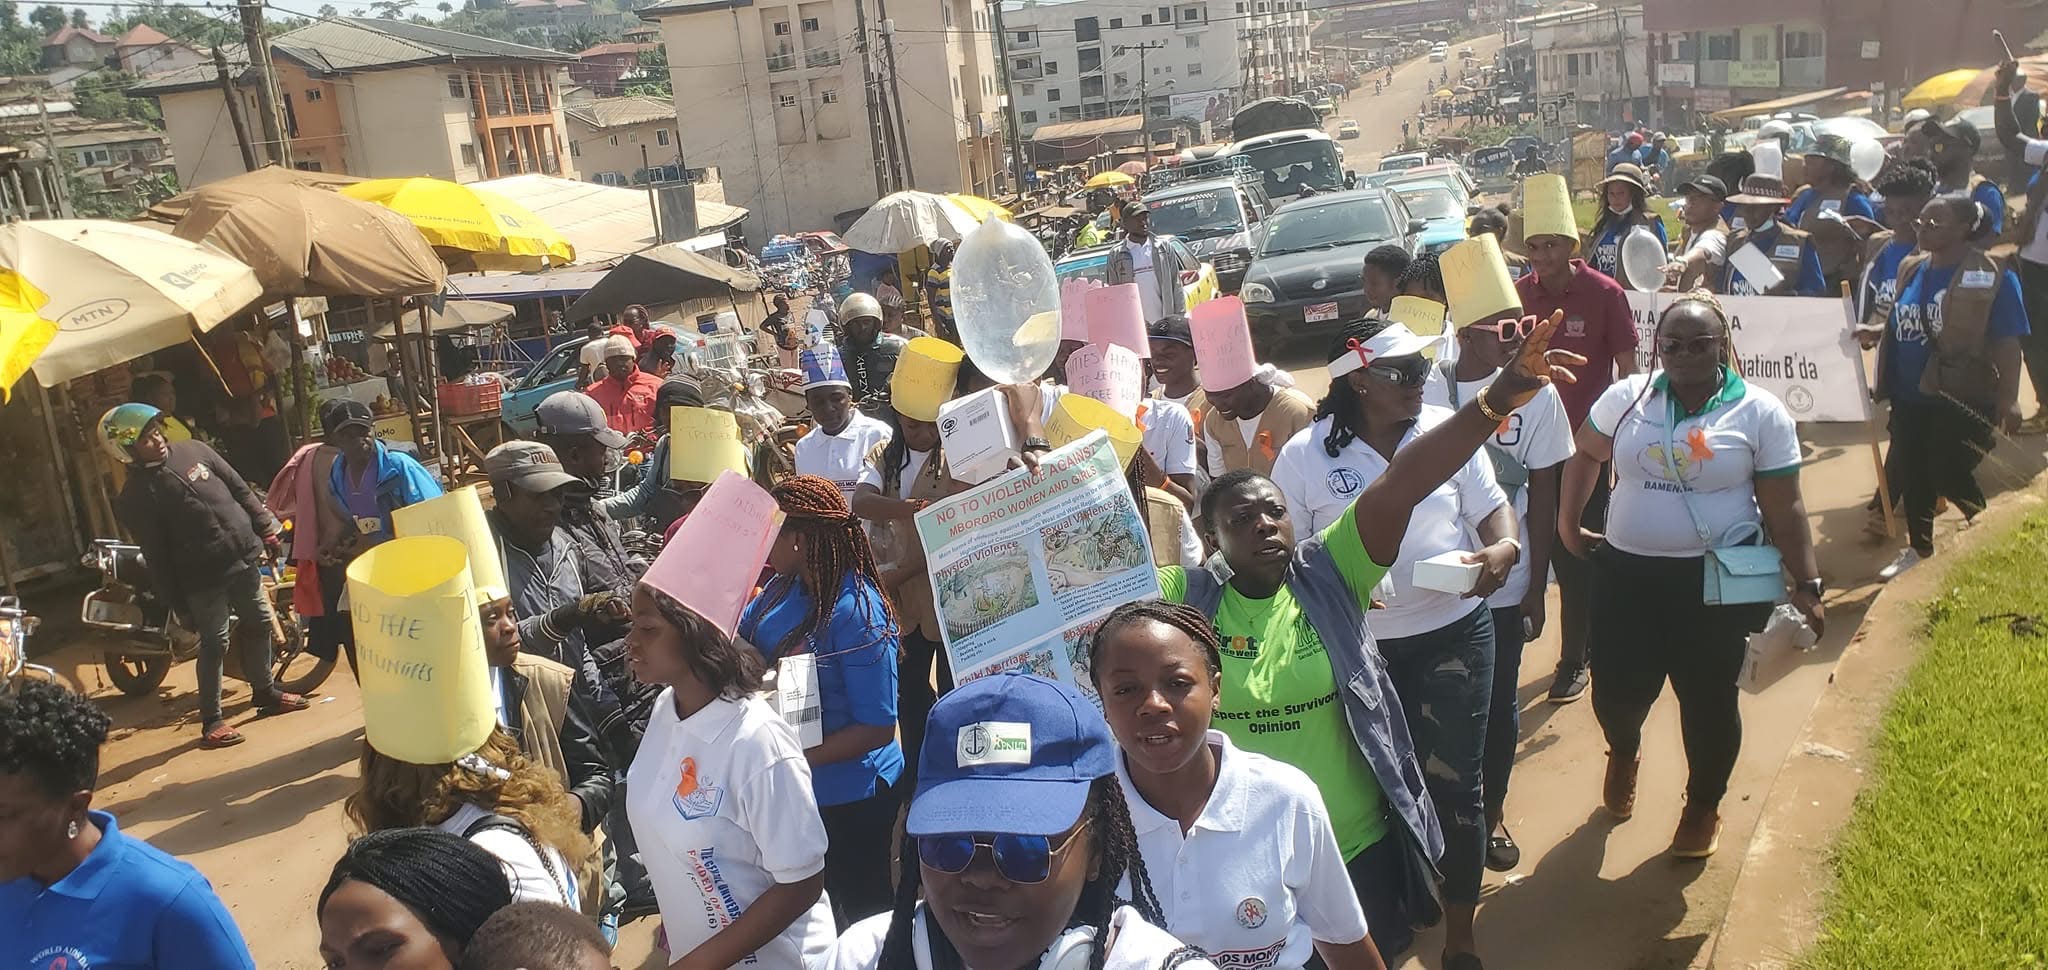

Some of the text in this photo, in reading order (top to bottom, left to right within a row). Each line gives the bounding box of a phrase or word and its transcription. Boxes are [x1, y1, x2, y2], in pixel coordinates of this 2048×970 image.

[72, 305, 115, 327] MTN
[936, 444, 1096, 525] NO TO VIOLENCE AGAINST
[949, 465, 1097, 537] MBORORO WOMEN AND GIRLS
[1040, 517, 1073, 538] Sexual
[935, 539, 1019, 578] Physical Violence
[376, 613, 424, 640] THE
[959, 651, 1030, 686] Child Marriage
[1212, 709, 1251, 722] spect
[1256, 708, 1280, 719] the
[1249, 720, 1301, 735] Opinion
[704, 900, 719, 929] 2016)
[717, 884, 742, 920] UNIVERS
[30, 945, 62, 964] WORLD
